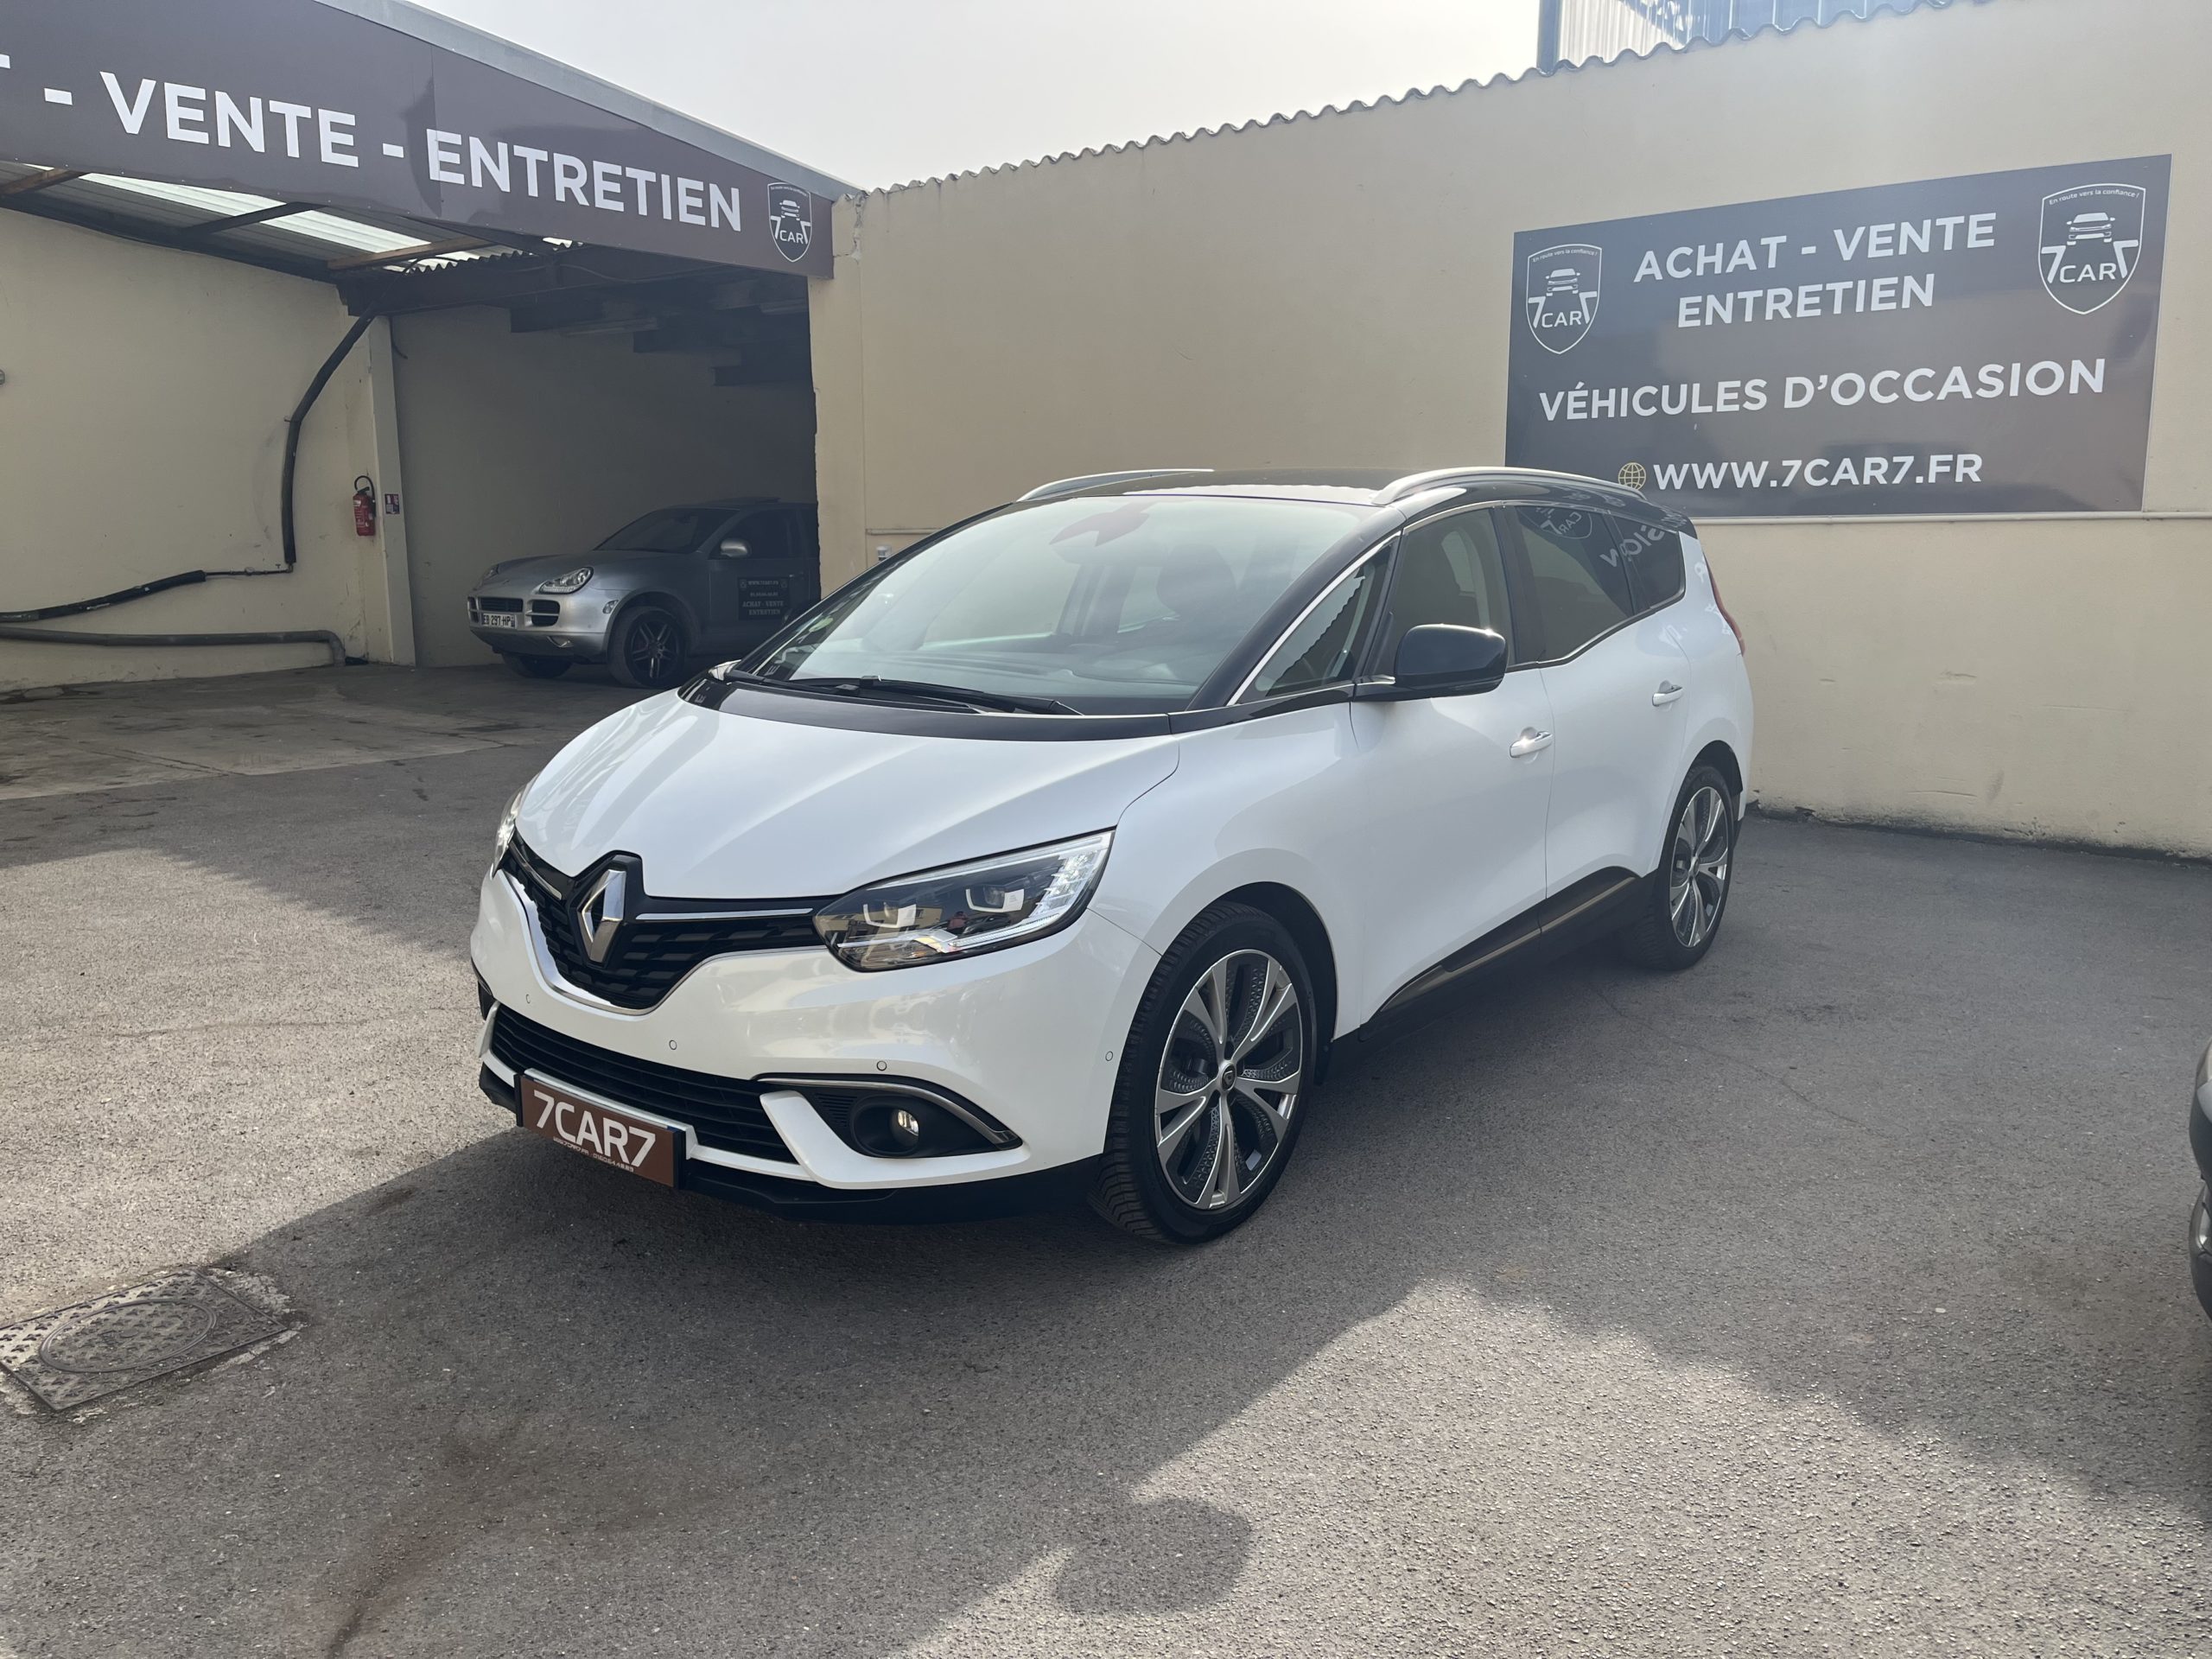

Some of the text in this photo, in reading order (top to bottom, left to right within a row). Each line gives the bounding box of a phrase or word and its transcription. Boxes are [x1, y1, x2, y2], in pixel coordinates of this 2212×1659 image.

[99, 71, 359, 168] VENTE
[426, 128, 741, 232] ENTRETIEN
[2059, 193, 2078, 202] route
[1633, 235, 1787, 283] ACHAT
[1833, 212, 1997, 261] VENTE
[2041, 239, 2139, 283] 7CAR7
[1528, 290, 1598, 329] 7CAR7
[1678, 273, 1936, 328] ENTRETIEN
[1538, 358, 2107, 422] VÉHICULES D'OCCASION
[1653, 453, 1984, 491] WWW.7CAR7.FR
[533, 1090, 656, 1167] 7CAR7
